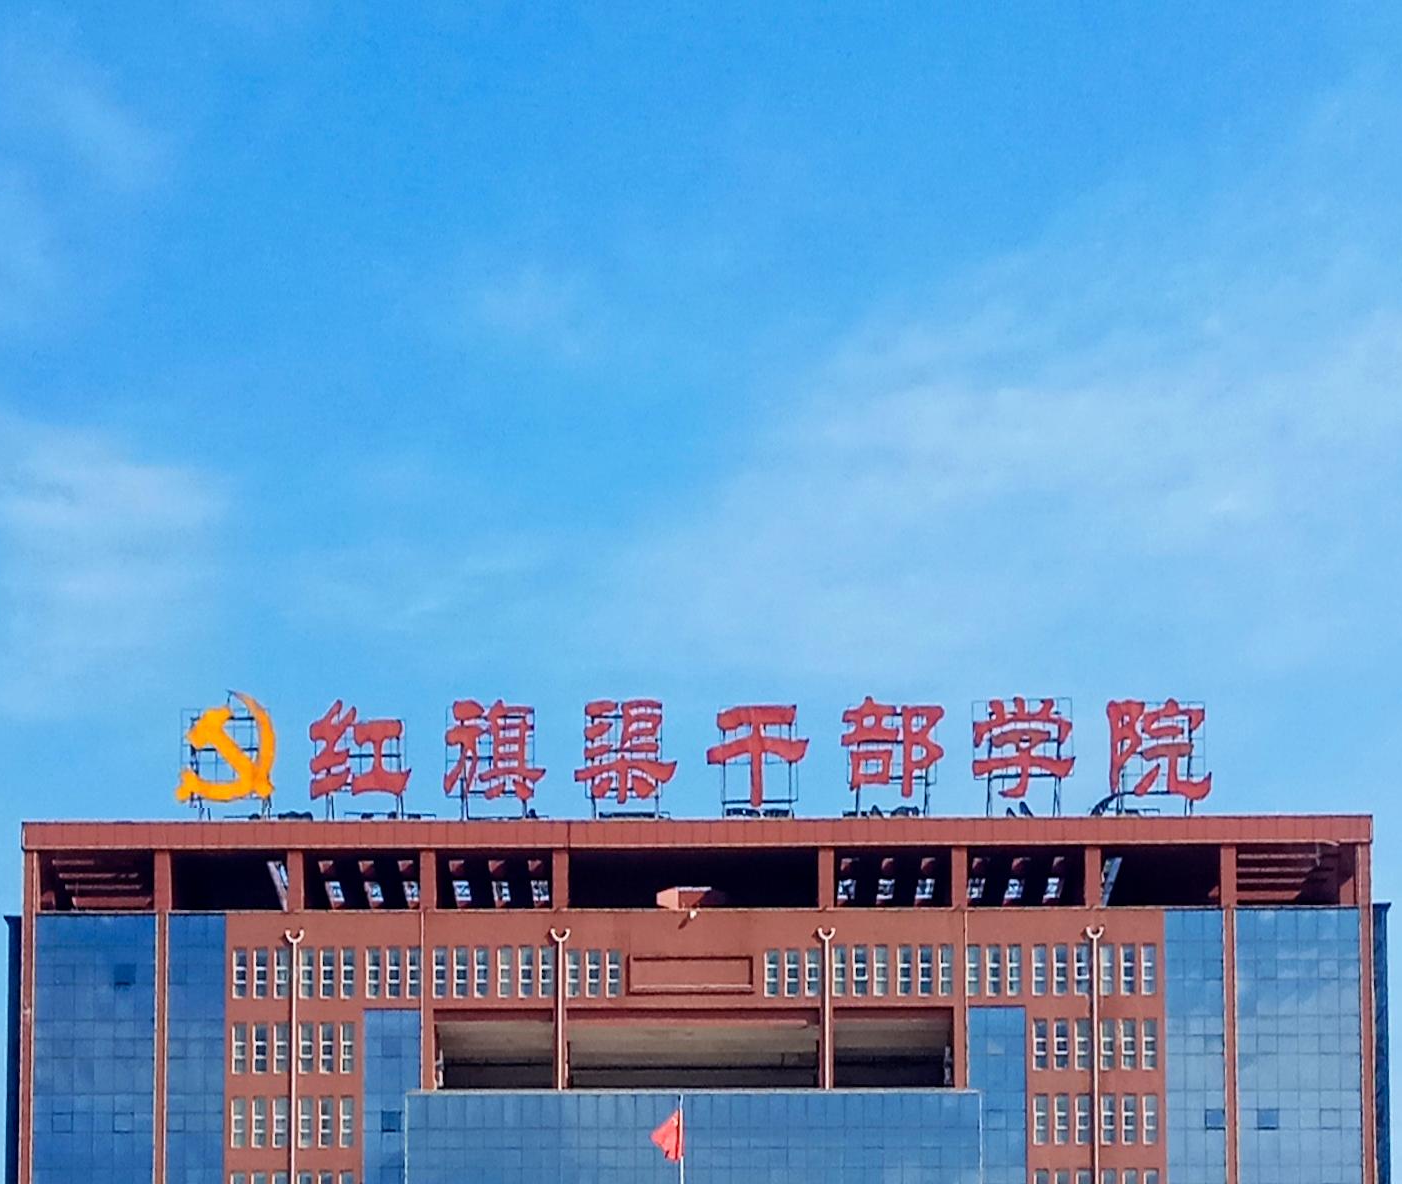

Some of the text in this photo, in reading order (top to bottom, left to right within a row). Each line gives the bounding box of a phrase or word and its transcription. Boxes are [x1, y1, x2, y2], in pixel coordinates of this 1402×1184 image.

[309, 696, 1213, 806] 红旗渠干部学院
